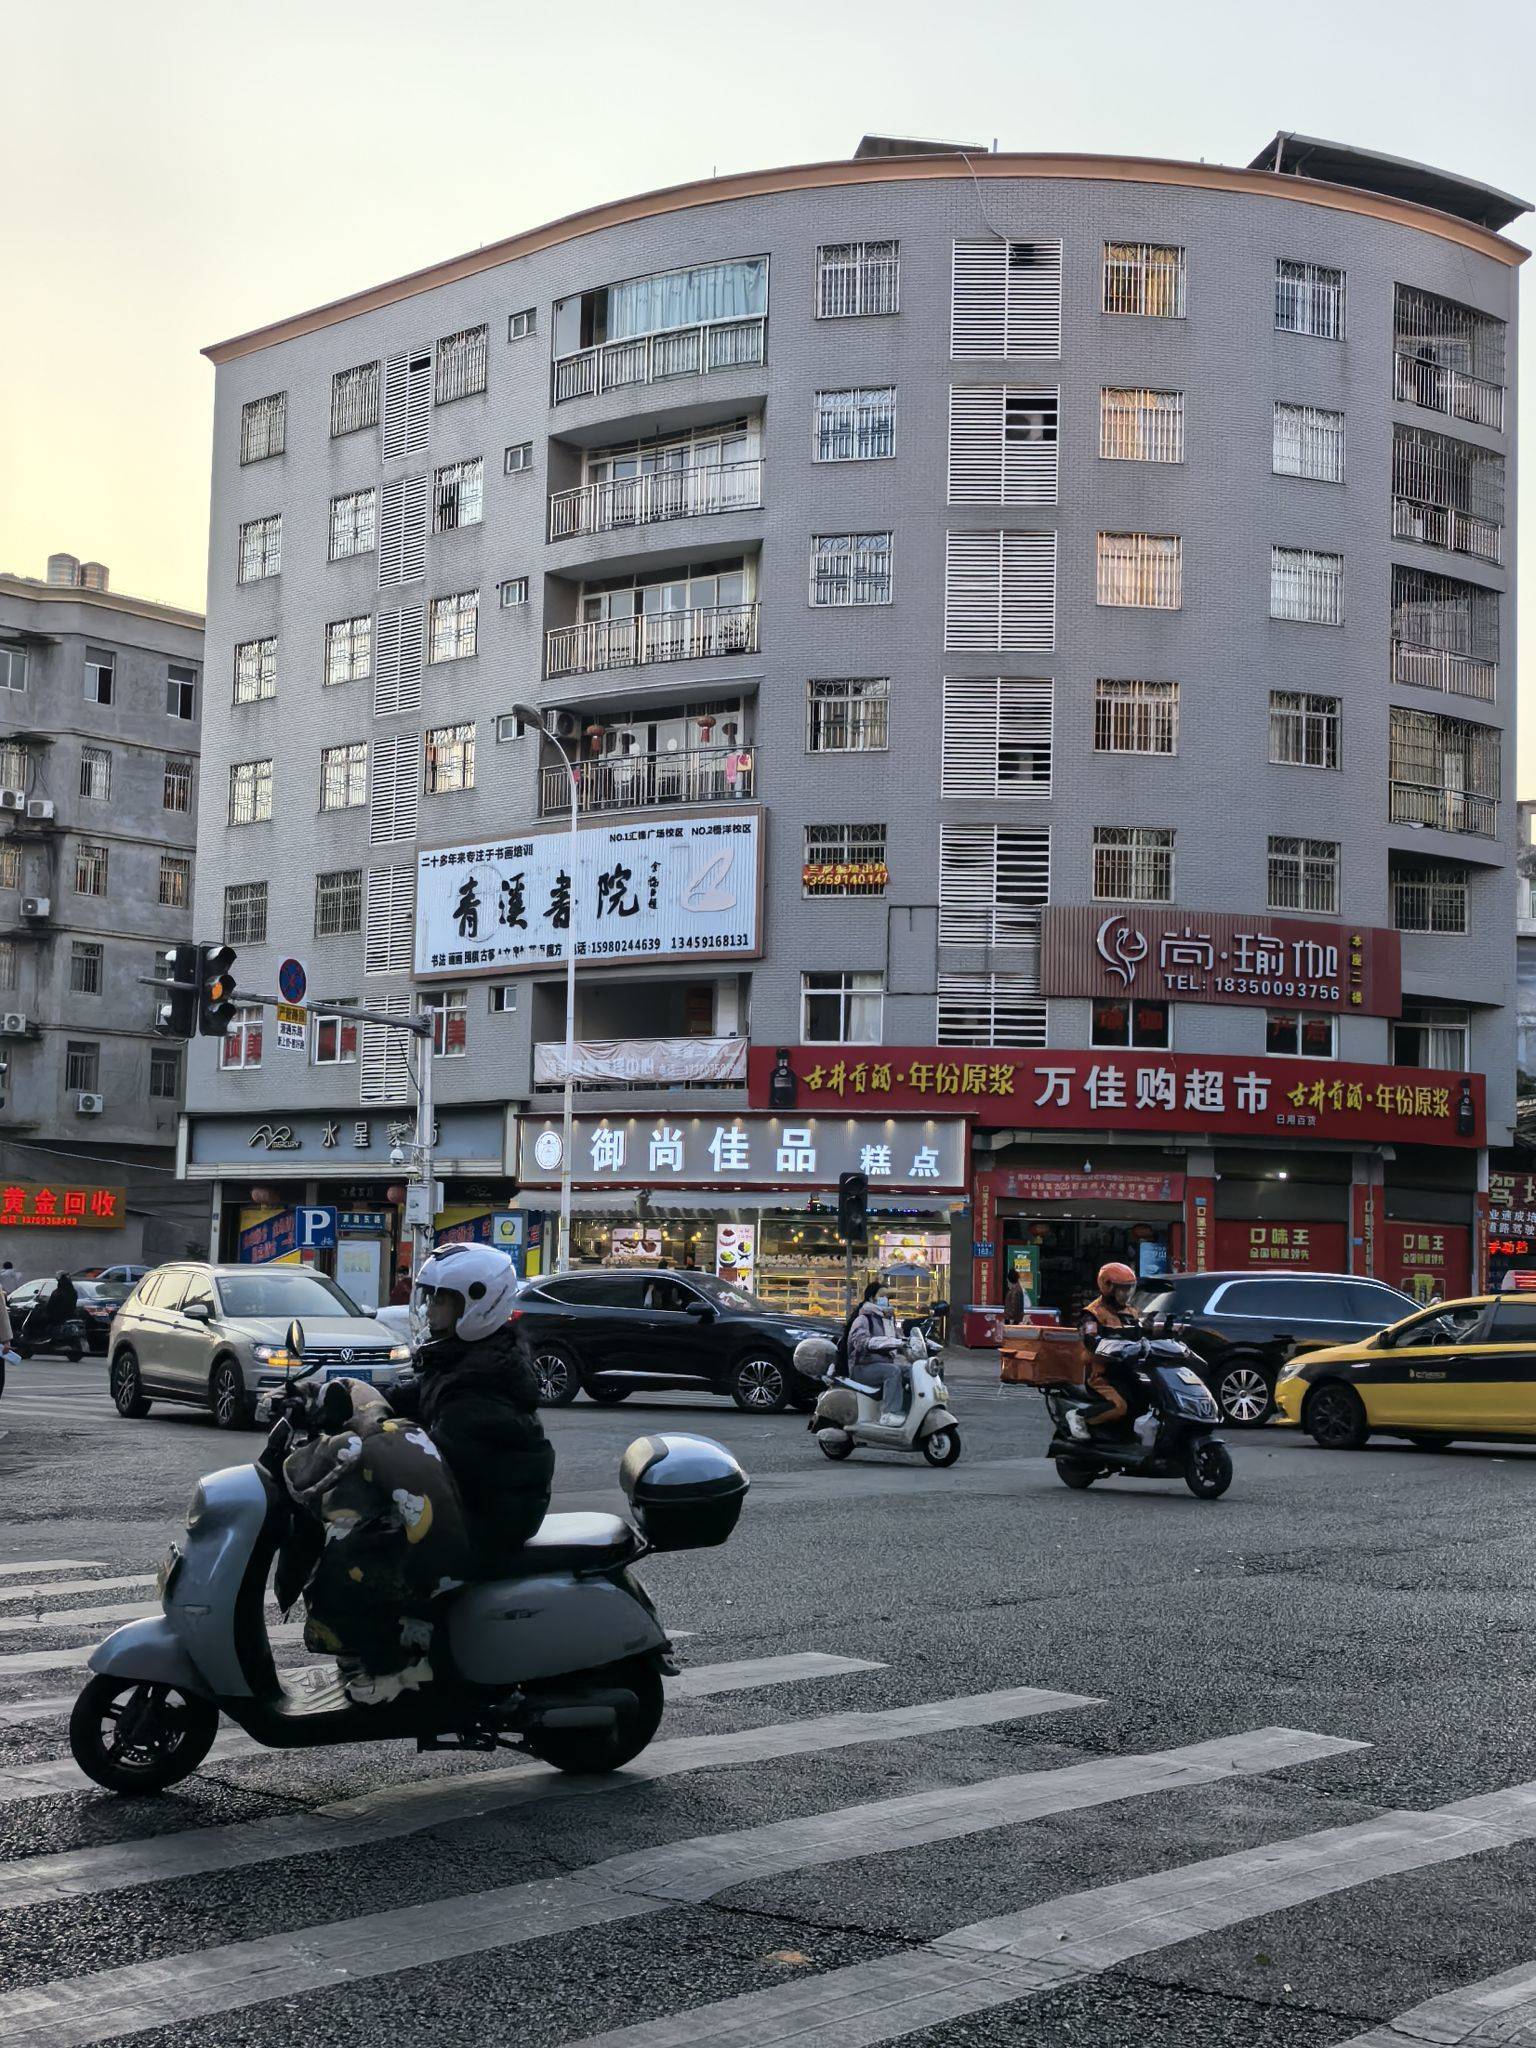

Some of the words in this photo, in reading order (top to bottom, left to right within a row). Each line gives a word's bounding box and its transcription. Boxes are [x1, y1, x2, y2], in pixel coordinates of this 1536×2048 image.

[421, 843, 534, 868] 二十多年来专注于书画培训
[431, 953, 446, 968] 书法
[464, 950, 480, 964] 围棋
[574, 937, 661, 956] 话:15980244639
[671, 934, 749, 949] 13459168131
[1164, 974, 1207, 991] TEL:
[1214, 977, 1340, 1000] 18350093756
[1033, 1065, 1272, 1115] 万佳购超市
[590, 1126, 818, 1173] 御尚佳品
[859, 1144, 940, 1177] 糕点
[2, 1186, 117, 1217] 黄金回收
[302, 1210, 331, 1246] P
[1250, 1227, 1310, 1245] 口味王
[1403, 1233, 1445, 1251] 口味王
